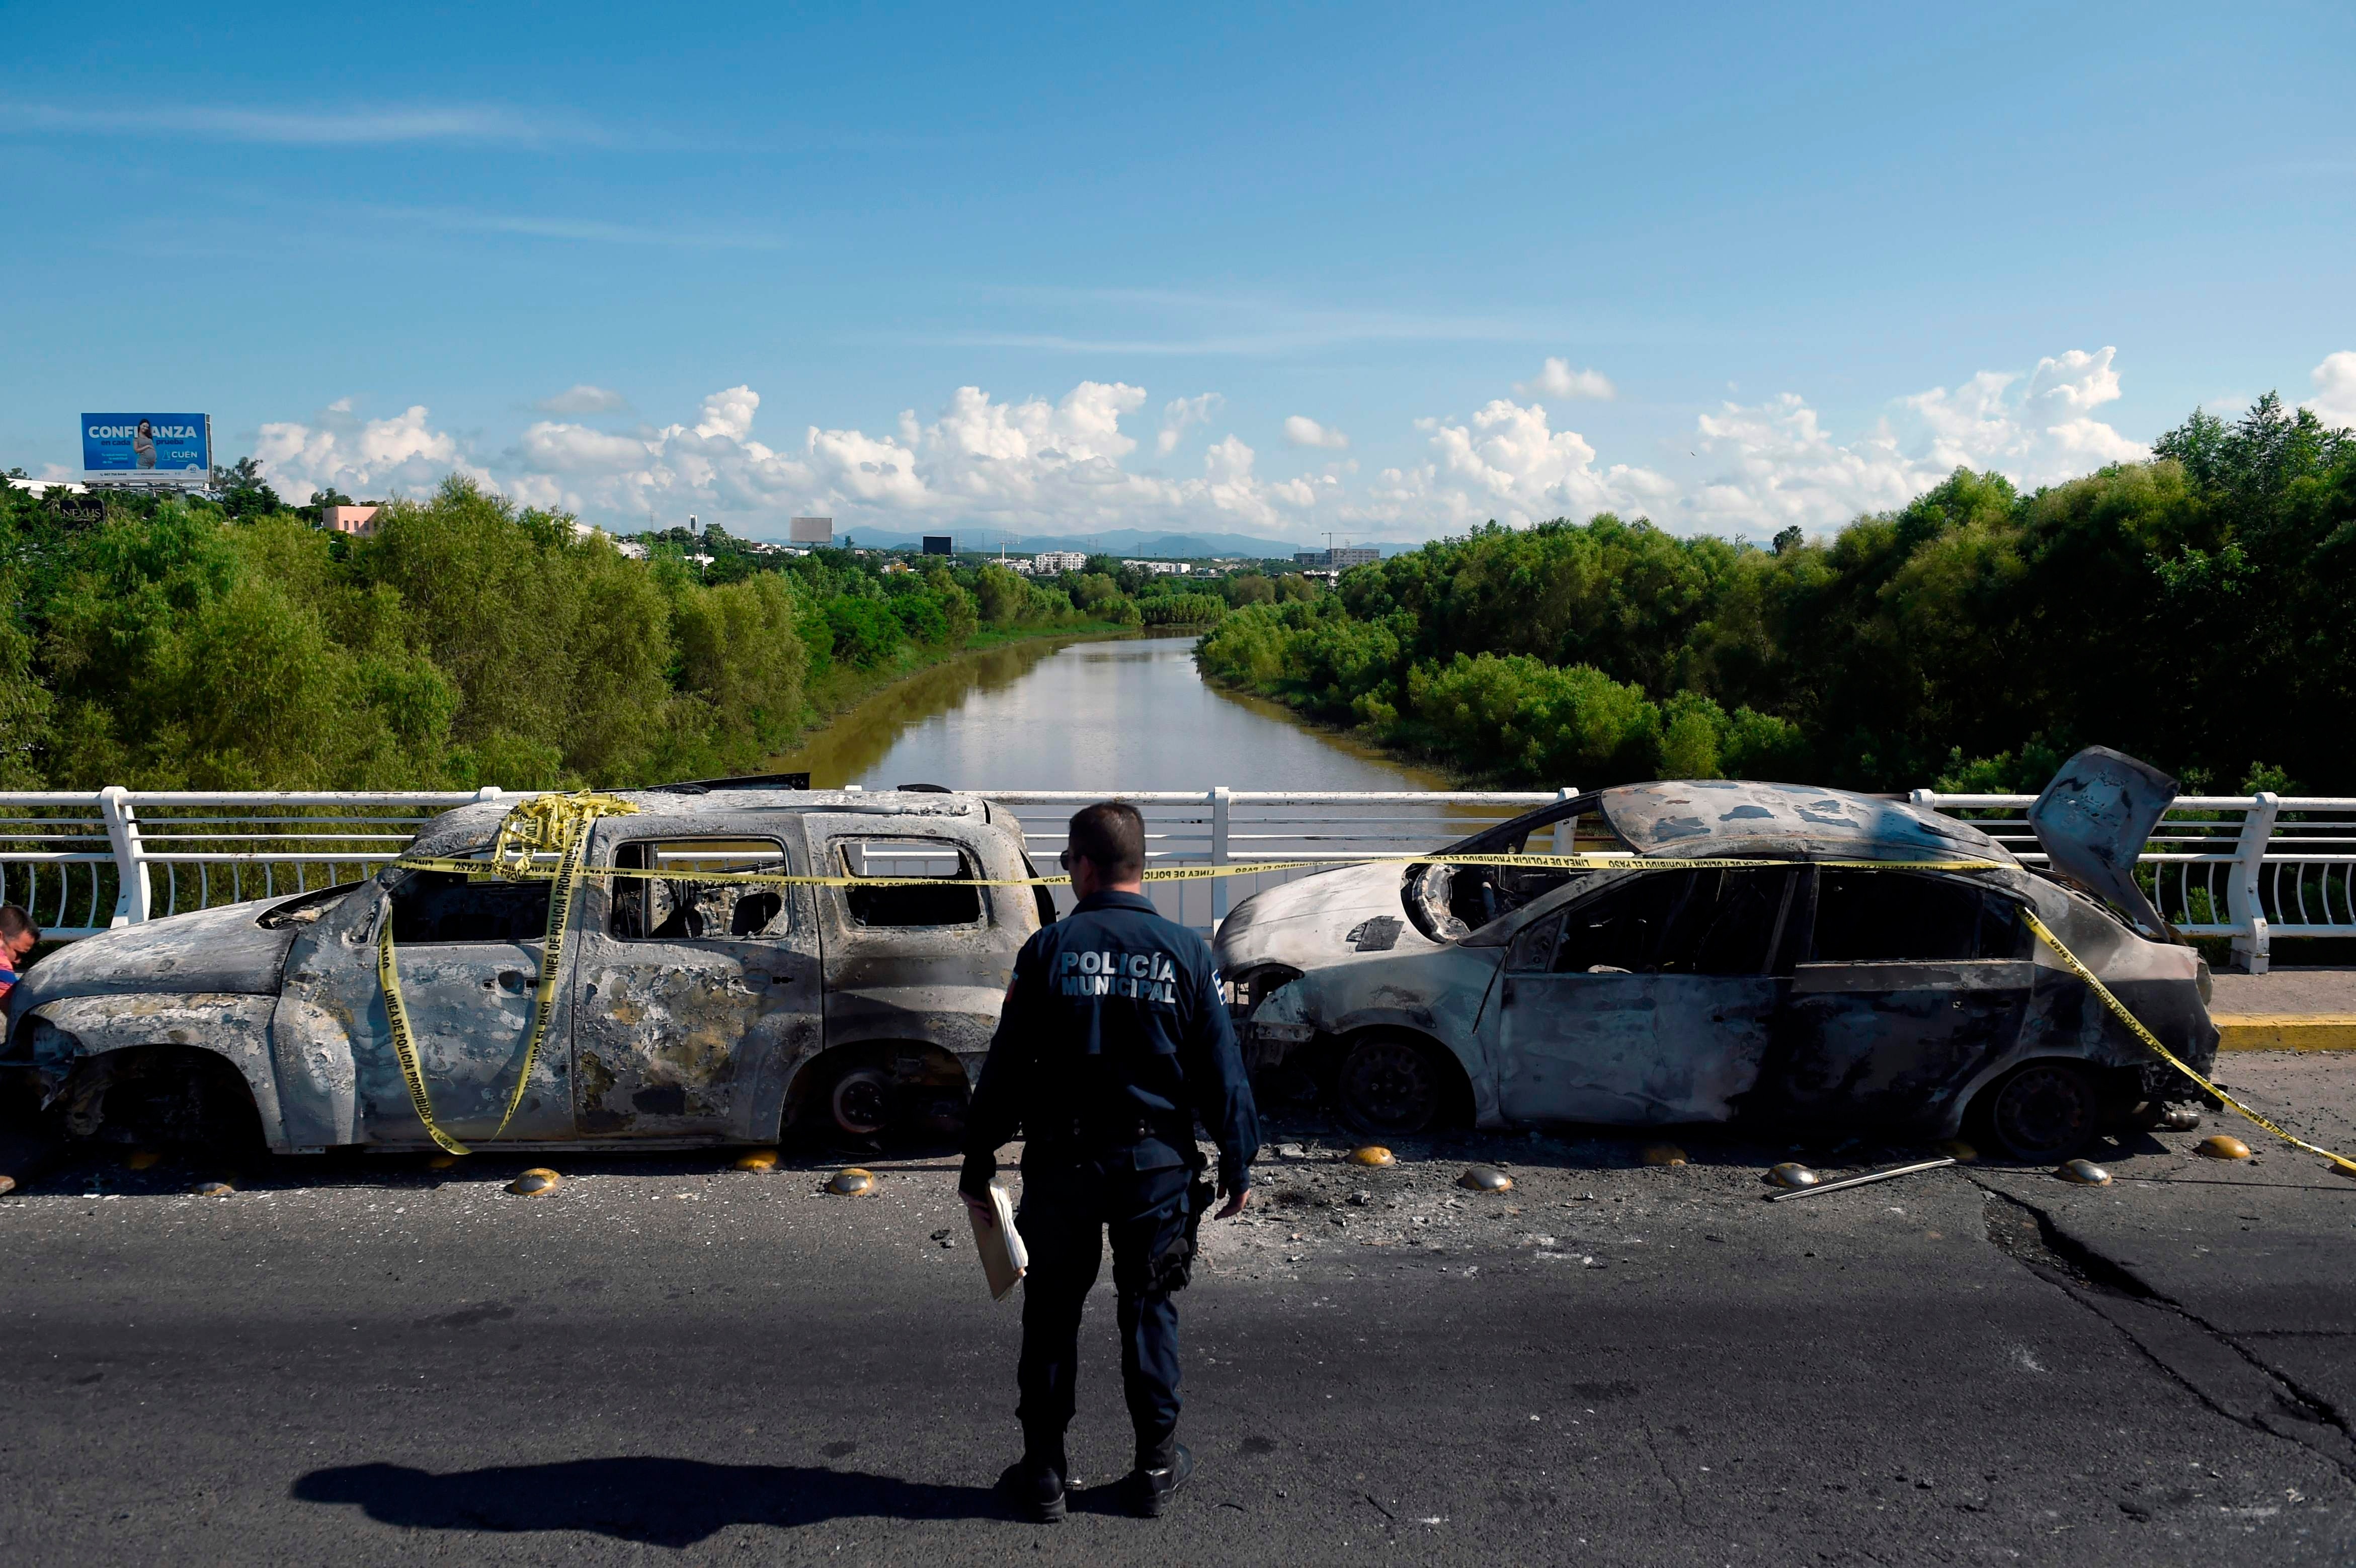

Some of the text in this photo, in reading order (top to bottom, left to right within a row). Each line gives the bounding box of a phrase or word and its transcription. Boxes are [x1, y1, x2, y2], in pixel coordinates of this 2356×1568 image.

[89, 426, 197, 438] CONFIANZA
[62, 509, 101, 518] NEXUS
[1513, 856, 1549, 865] POLICIA
[1550, 858, 1562, 866] DE
[1563, 858, 1590, 867] LINEA
[1608, 860, 1632, 869] PASO
[550, 896, 568, 936] POLICIA
[547, 937, 561, 951] DE
[544, 953, 559, 980] LINEA
[1062, 951, 1175, 982] POLICÍA
[1062, 975, 1175, 1003] MUNICIPAL
[384, 989, 399, 1017] LINEA
[391, 1017, 404, 1032] DE
[396, 1032, 415, 1070] POLICIA
